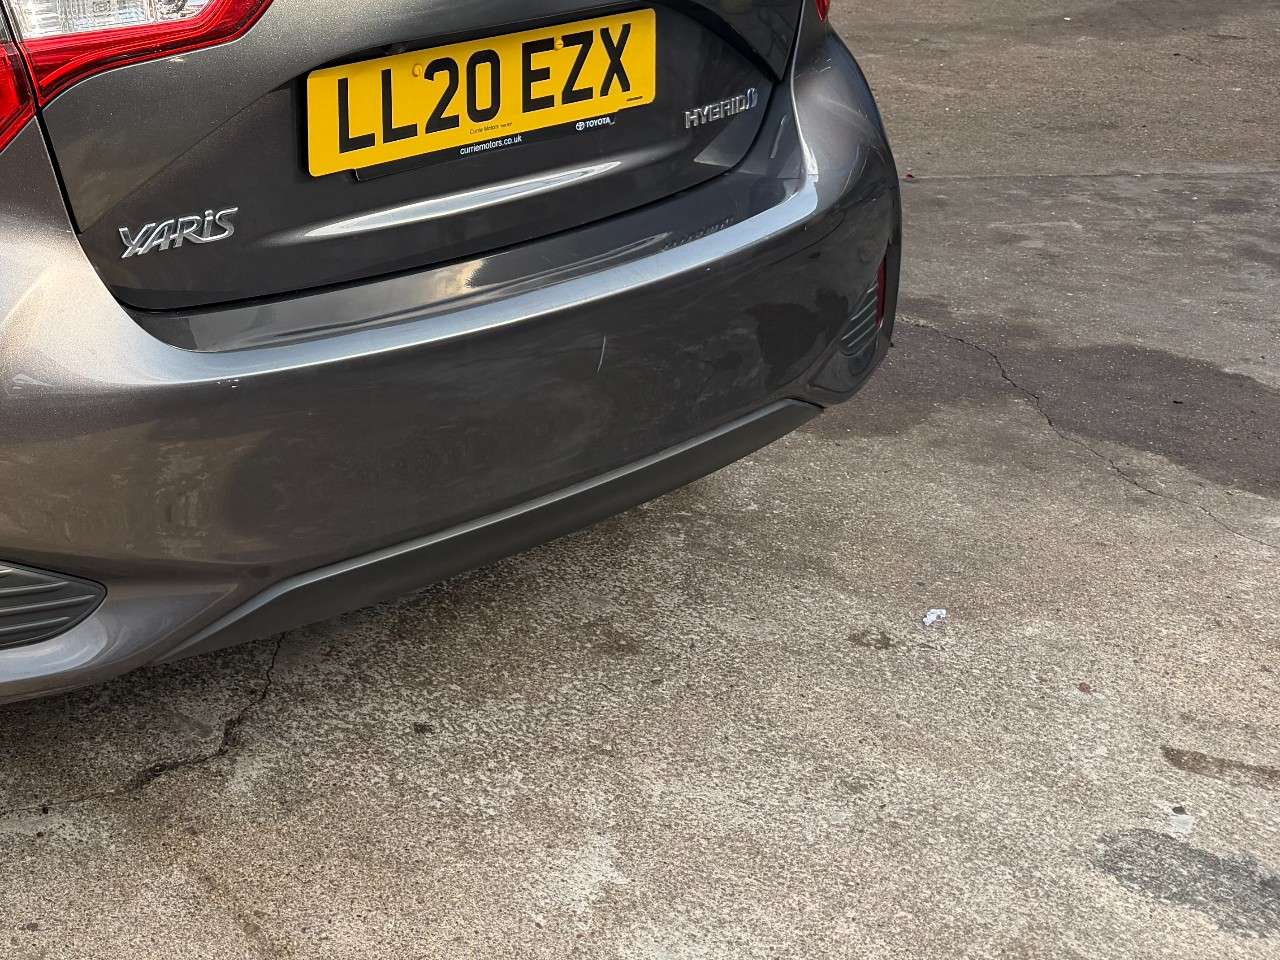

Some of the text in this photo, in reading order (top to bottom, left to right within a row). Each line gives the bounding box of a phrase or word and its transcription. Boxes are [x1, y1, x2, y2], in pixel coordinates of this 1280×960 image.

[337, 23, 632, 154] LL20 EZX
[585, 116, 611, 129] TOYOTA
[684, 95, 748, 129] HYBRID
[459, 134, 523, 156] curriemotors.co.uk
